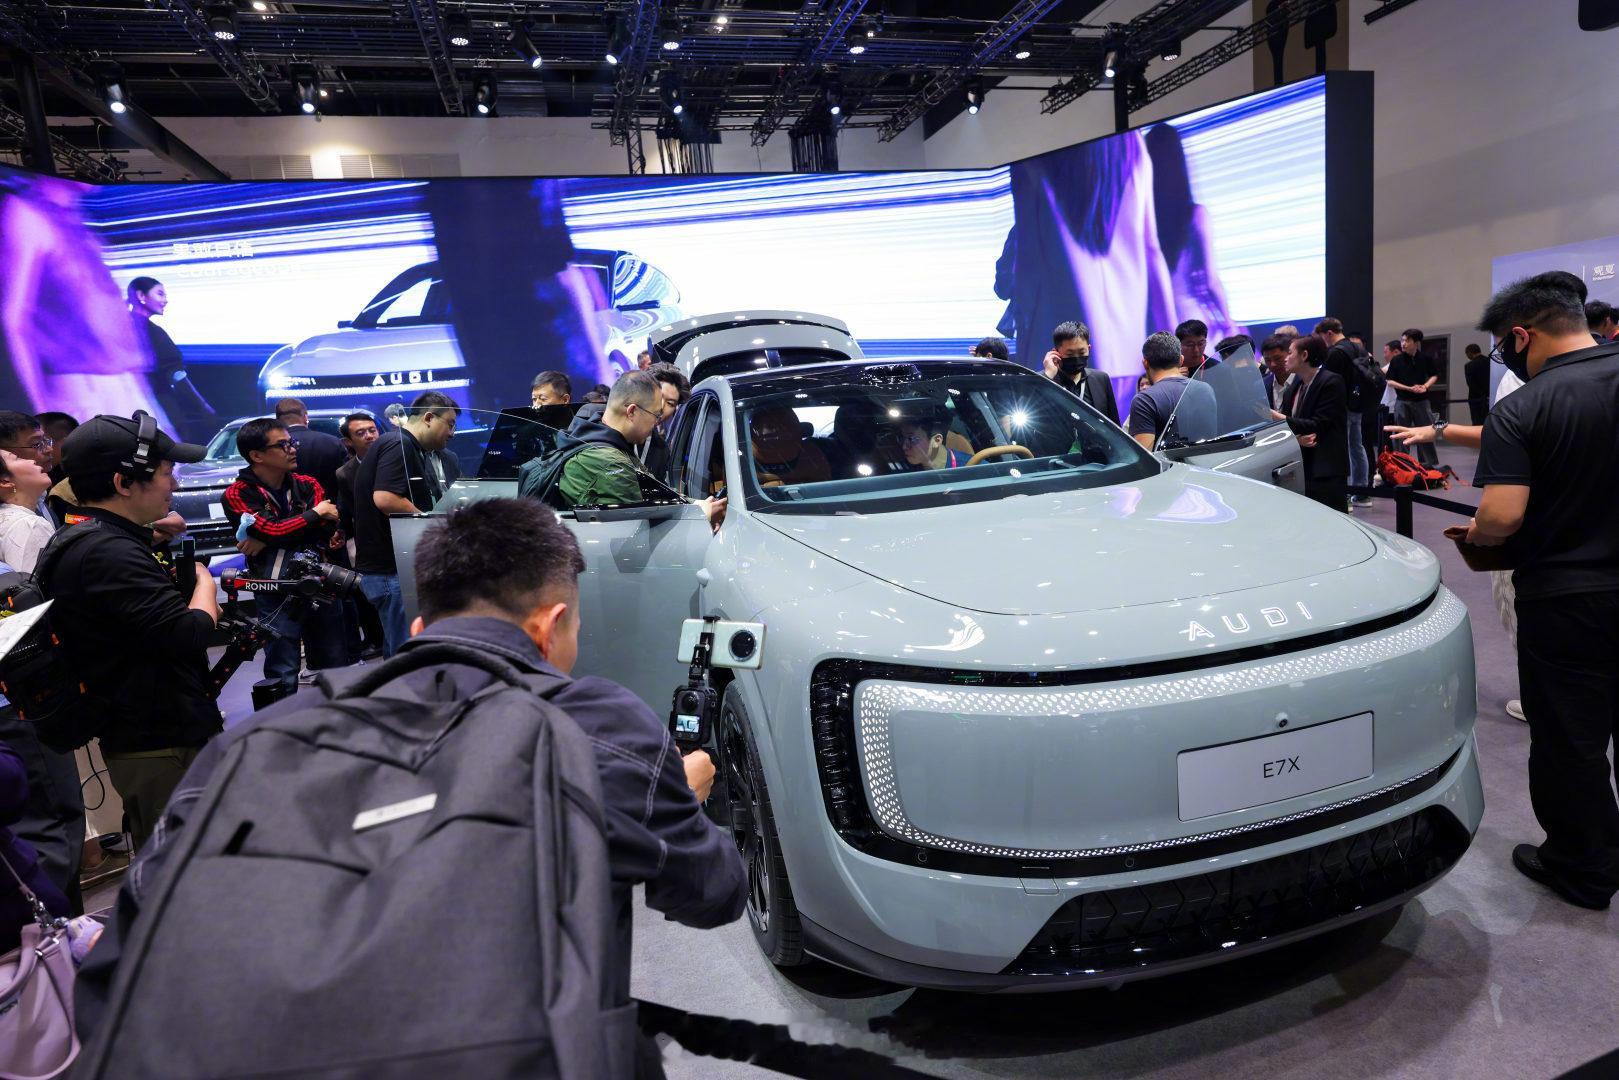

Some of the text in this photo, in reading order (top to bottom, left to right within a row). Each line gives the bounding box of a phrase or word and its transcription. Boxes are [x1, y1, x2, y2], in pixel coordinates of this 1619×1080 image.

[372, 370, 433, 386] AUDI
[245, 582, 279, 591] RONIN
[1189, 601, 1313, 642] AUDI
[1263, 755, 1300, 778] E7X
